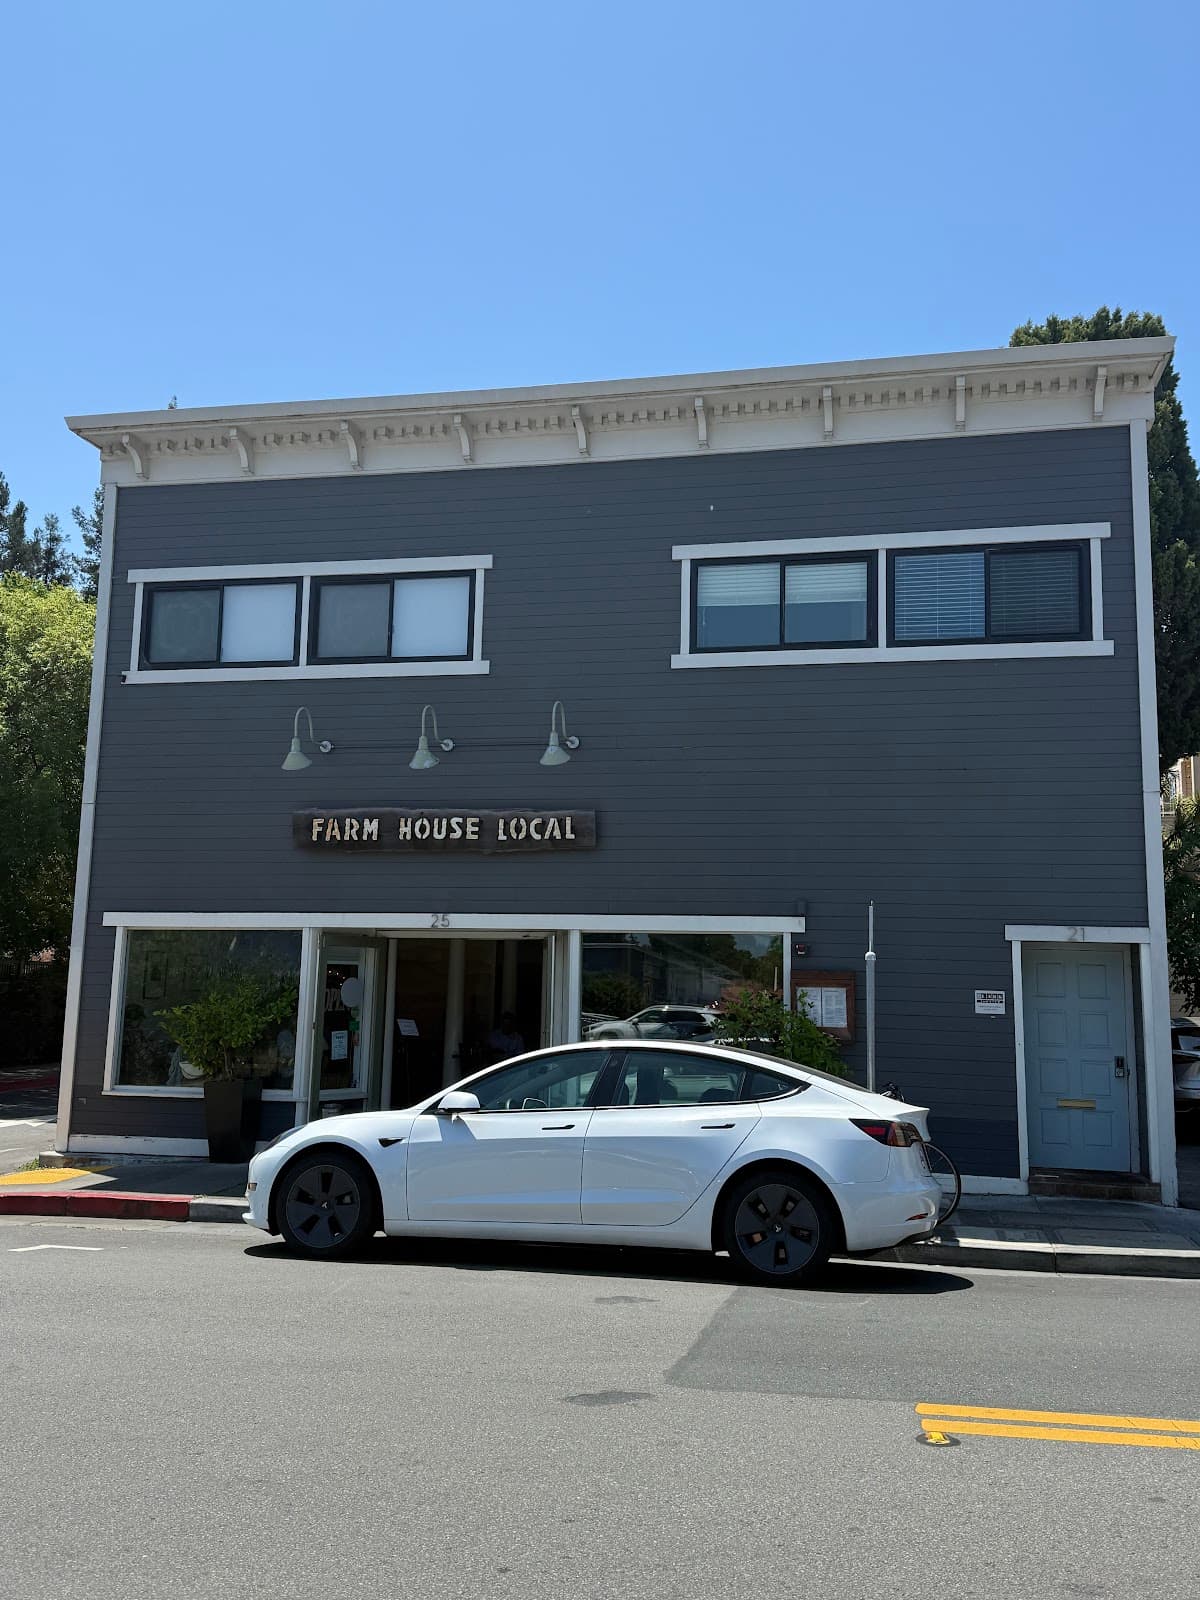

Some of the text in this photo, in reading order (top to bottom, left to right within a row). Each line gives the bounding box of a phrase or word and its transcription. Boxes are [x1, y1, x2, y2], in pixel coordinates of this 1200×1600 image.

[311, 816, 576, 841] FARM HOUSE LOCAL
[431, 914, 450, 928] 25
[1067, 926, 1085, 941] 21
